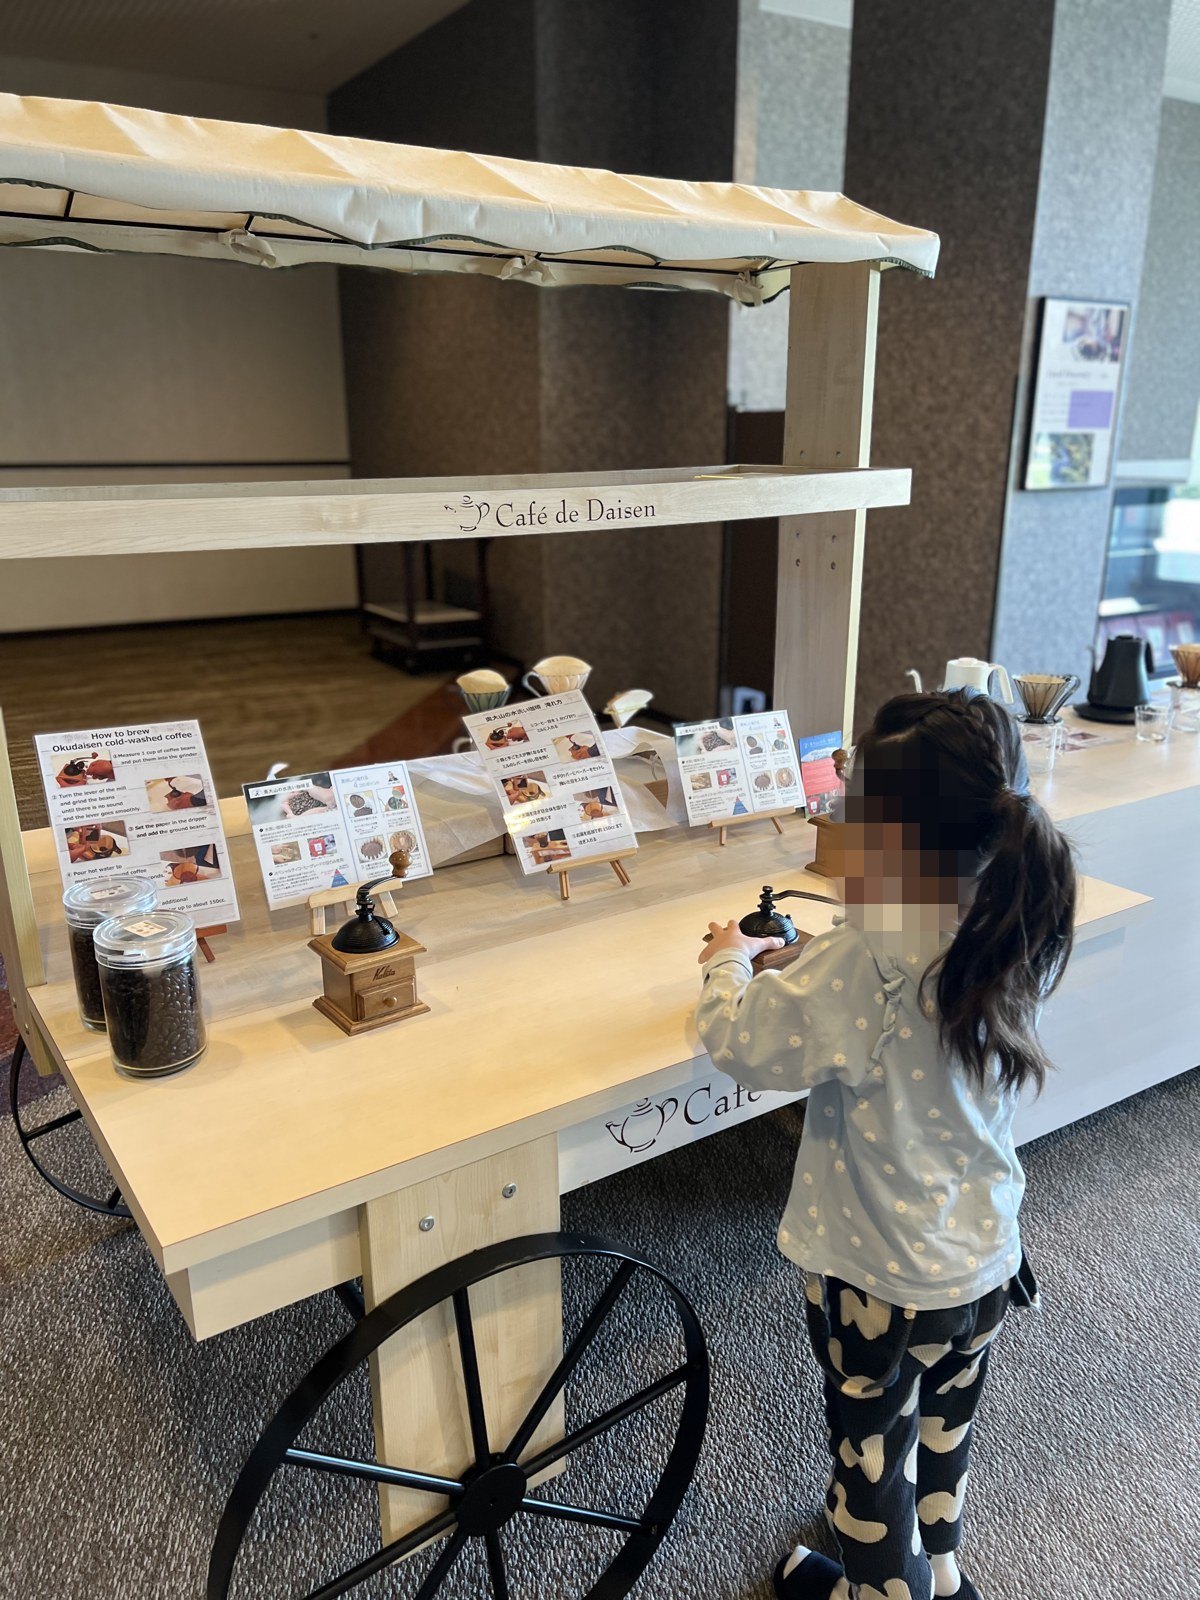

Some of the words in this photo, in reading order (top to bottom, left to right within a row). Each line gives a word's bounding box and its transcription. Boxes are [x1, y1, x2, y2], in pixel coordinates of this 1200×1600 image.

[496, 501, 547, 527] Café
[556, 499, 579, 523] de
[586, 498, 656, 522] Daisen
[52, 741, 102, 752] Okudaisen
[105, 734, 162, 747] cold-washed
[165, 732, 192, 741] coffee
[162, 897, 188, 905] additional
[373, 965, 396, 981] Kalita
